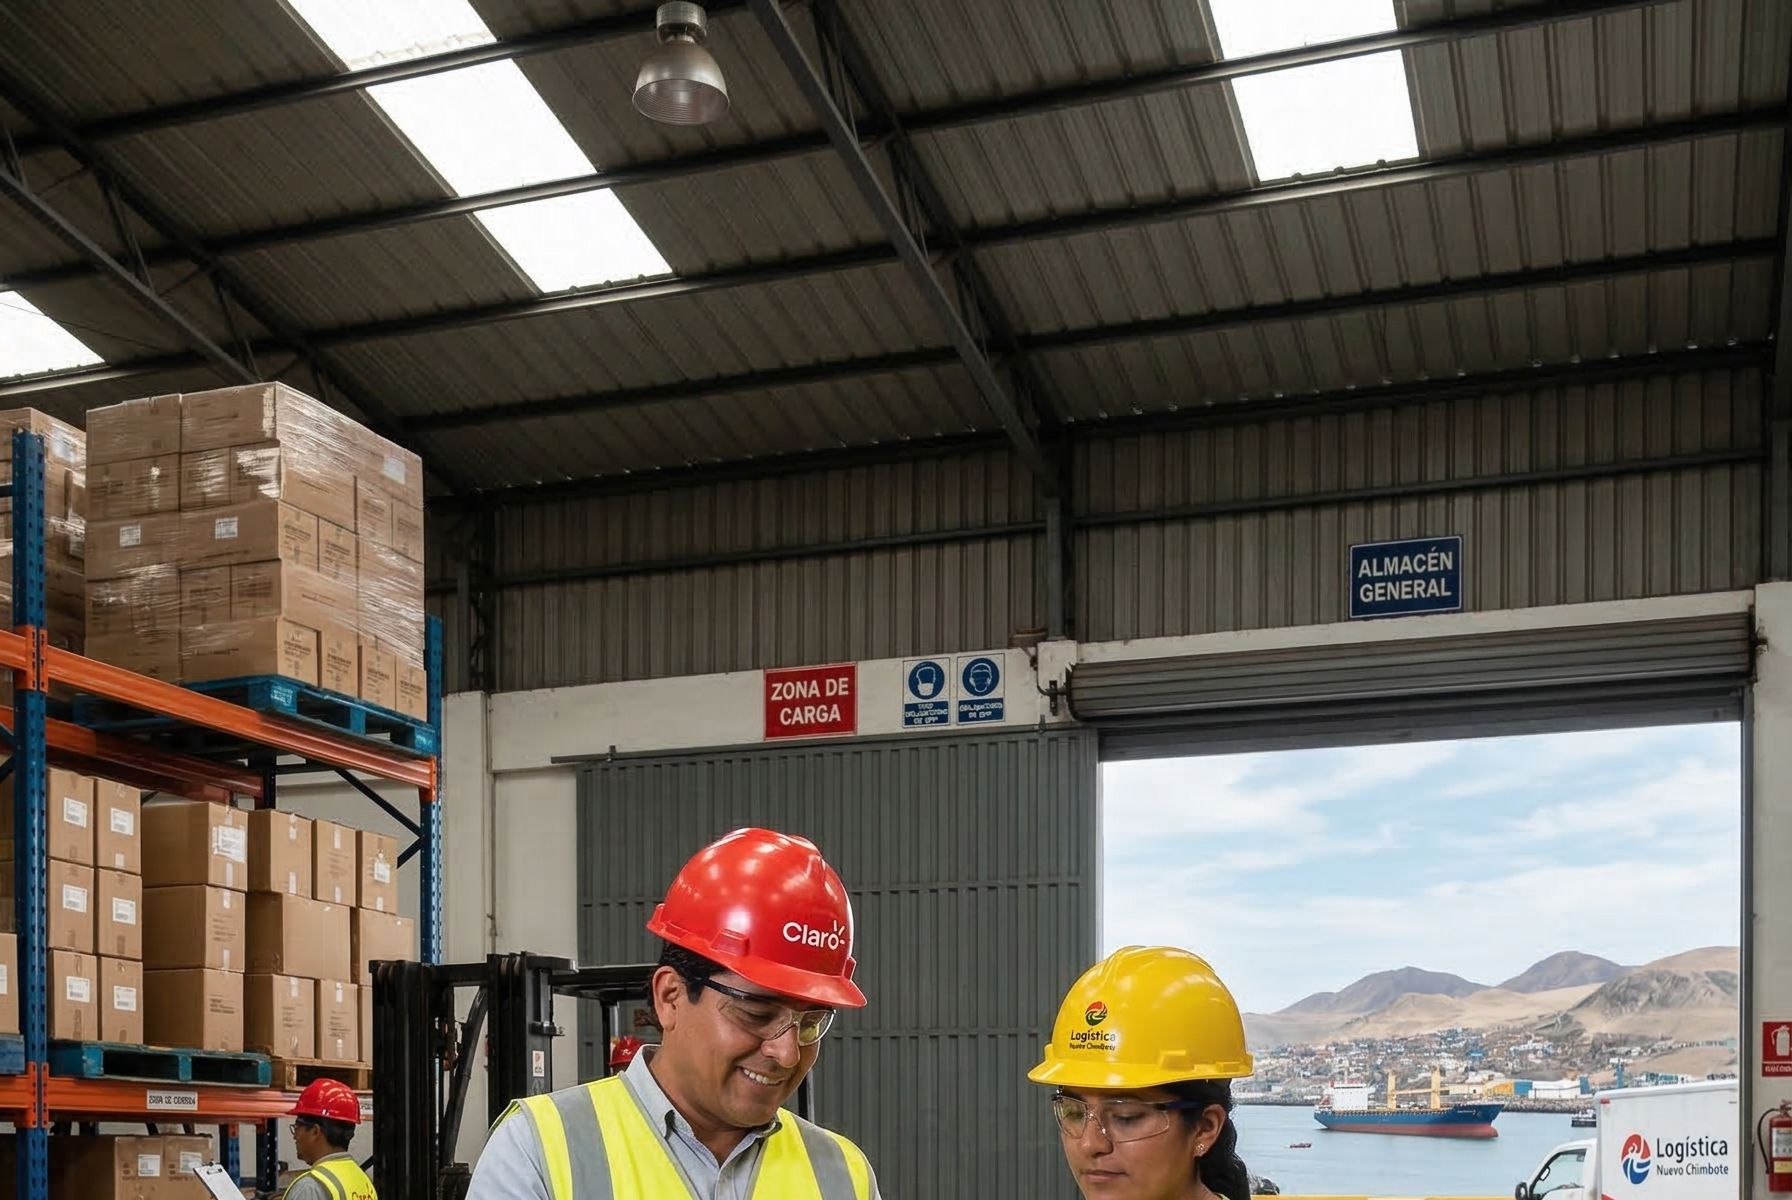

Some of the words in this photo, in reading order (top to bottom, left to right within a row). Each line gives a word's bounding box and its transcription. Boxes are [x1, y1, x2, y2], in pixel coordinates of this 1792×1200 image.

[1358, 546, 1453, 578] ALMACÉN
[1360, 578, 1452, 602] GENERAL
[771, 679, 821, 701] ZONA
[825, 677, 849, 697] DE
[780, 704, 841, 725] CARGA
[782, 919, 845, 951] Claro
[1656, 1135, 1728, 1164] Logística
[1656, 1164, 1684, 1176] Nuevo
[1685, 1162, 1729, 1176] Chimbote
